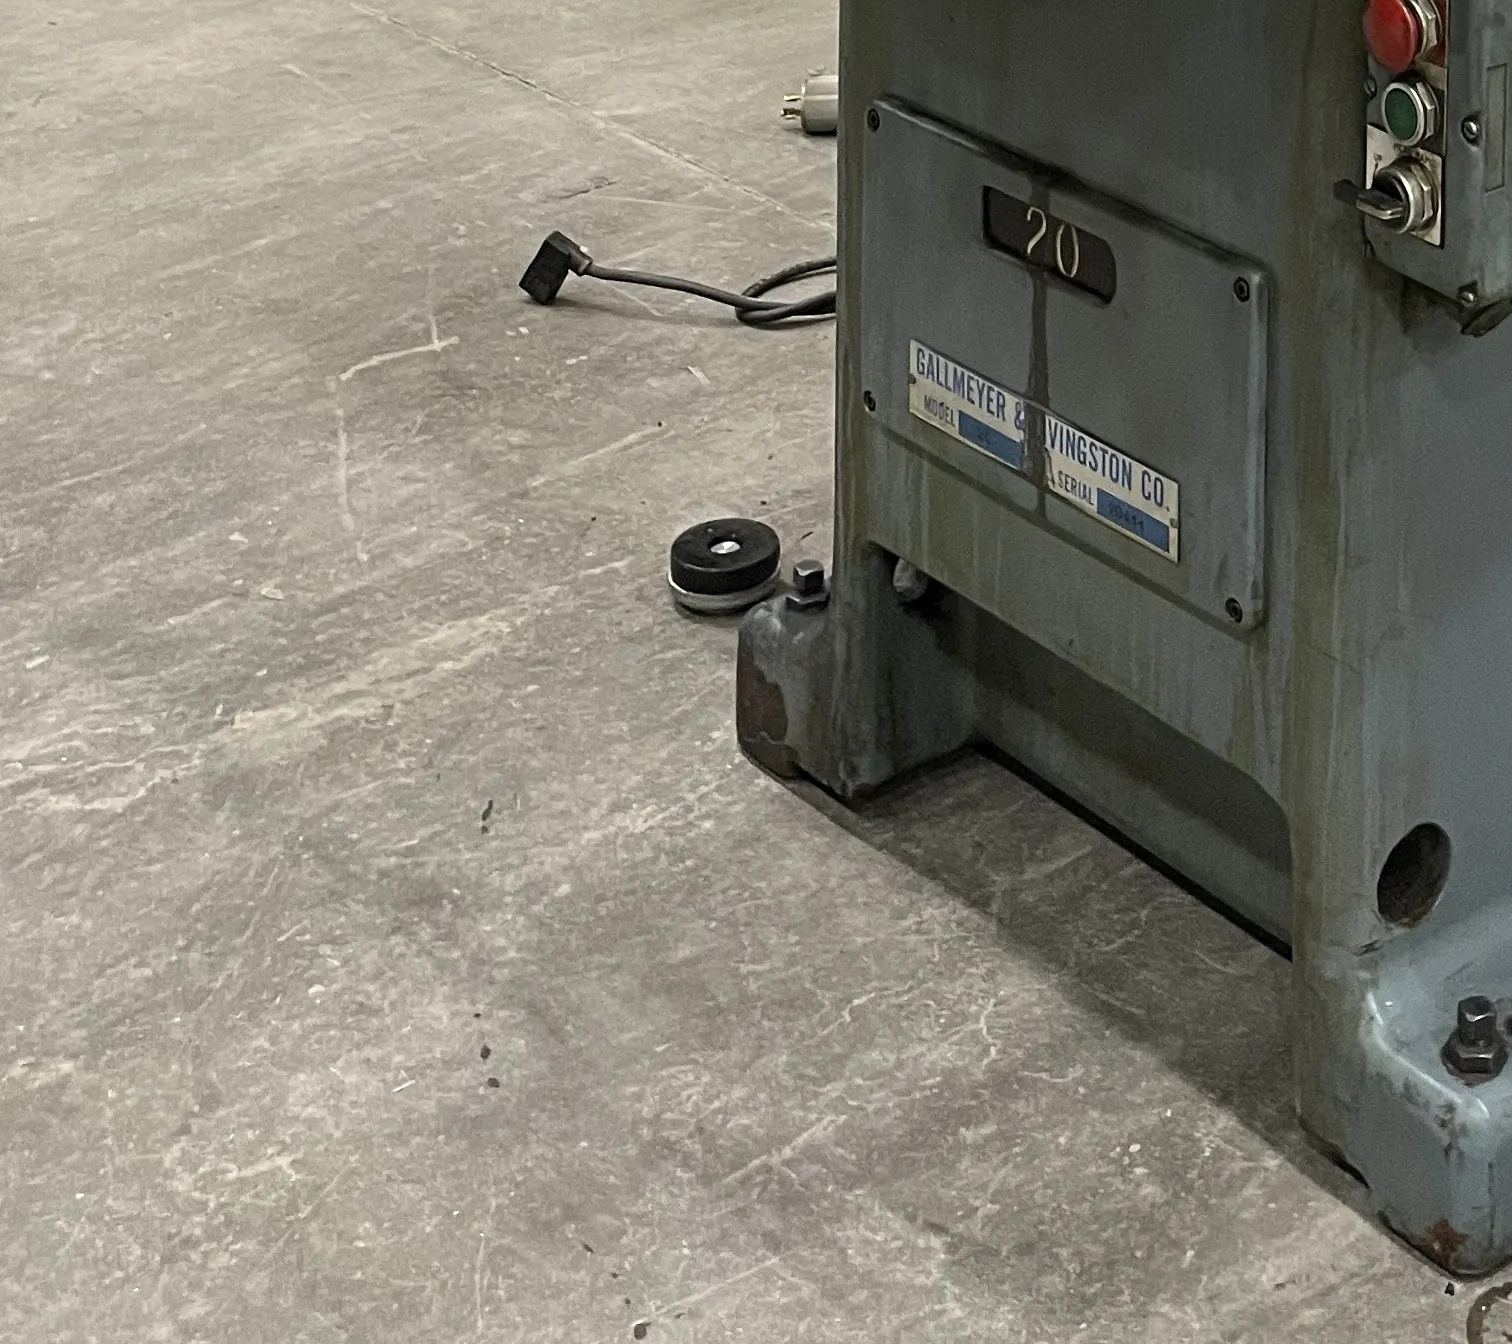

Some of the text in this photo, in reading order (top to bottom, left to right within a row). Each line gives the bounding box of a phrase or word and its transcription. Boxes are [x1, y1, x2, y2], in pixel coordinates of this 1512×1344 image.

[924, 393, 956, 428] MODEL
[916, 347, 1006, 422] GALLMEYER
[1047, 417, 1133, 492] VINGSTON
[1141, 469, 1170, 512] CO.
[1057, 470, 1095, 506] SERIAL
